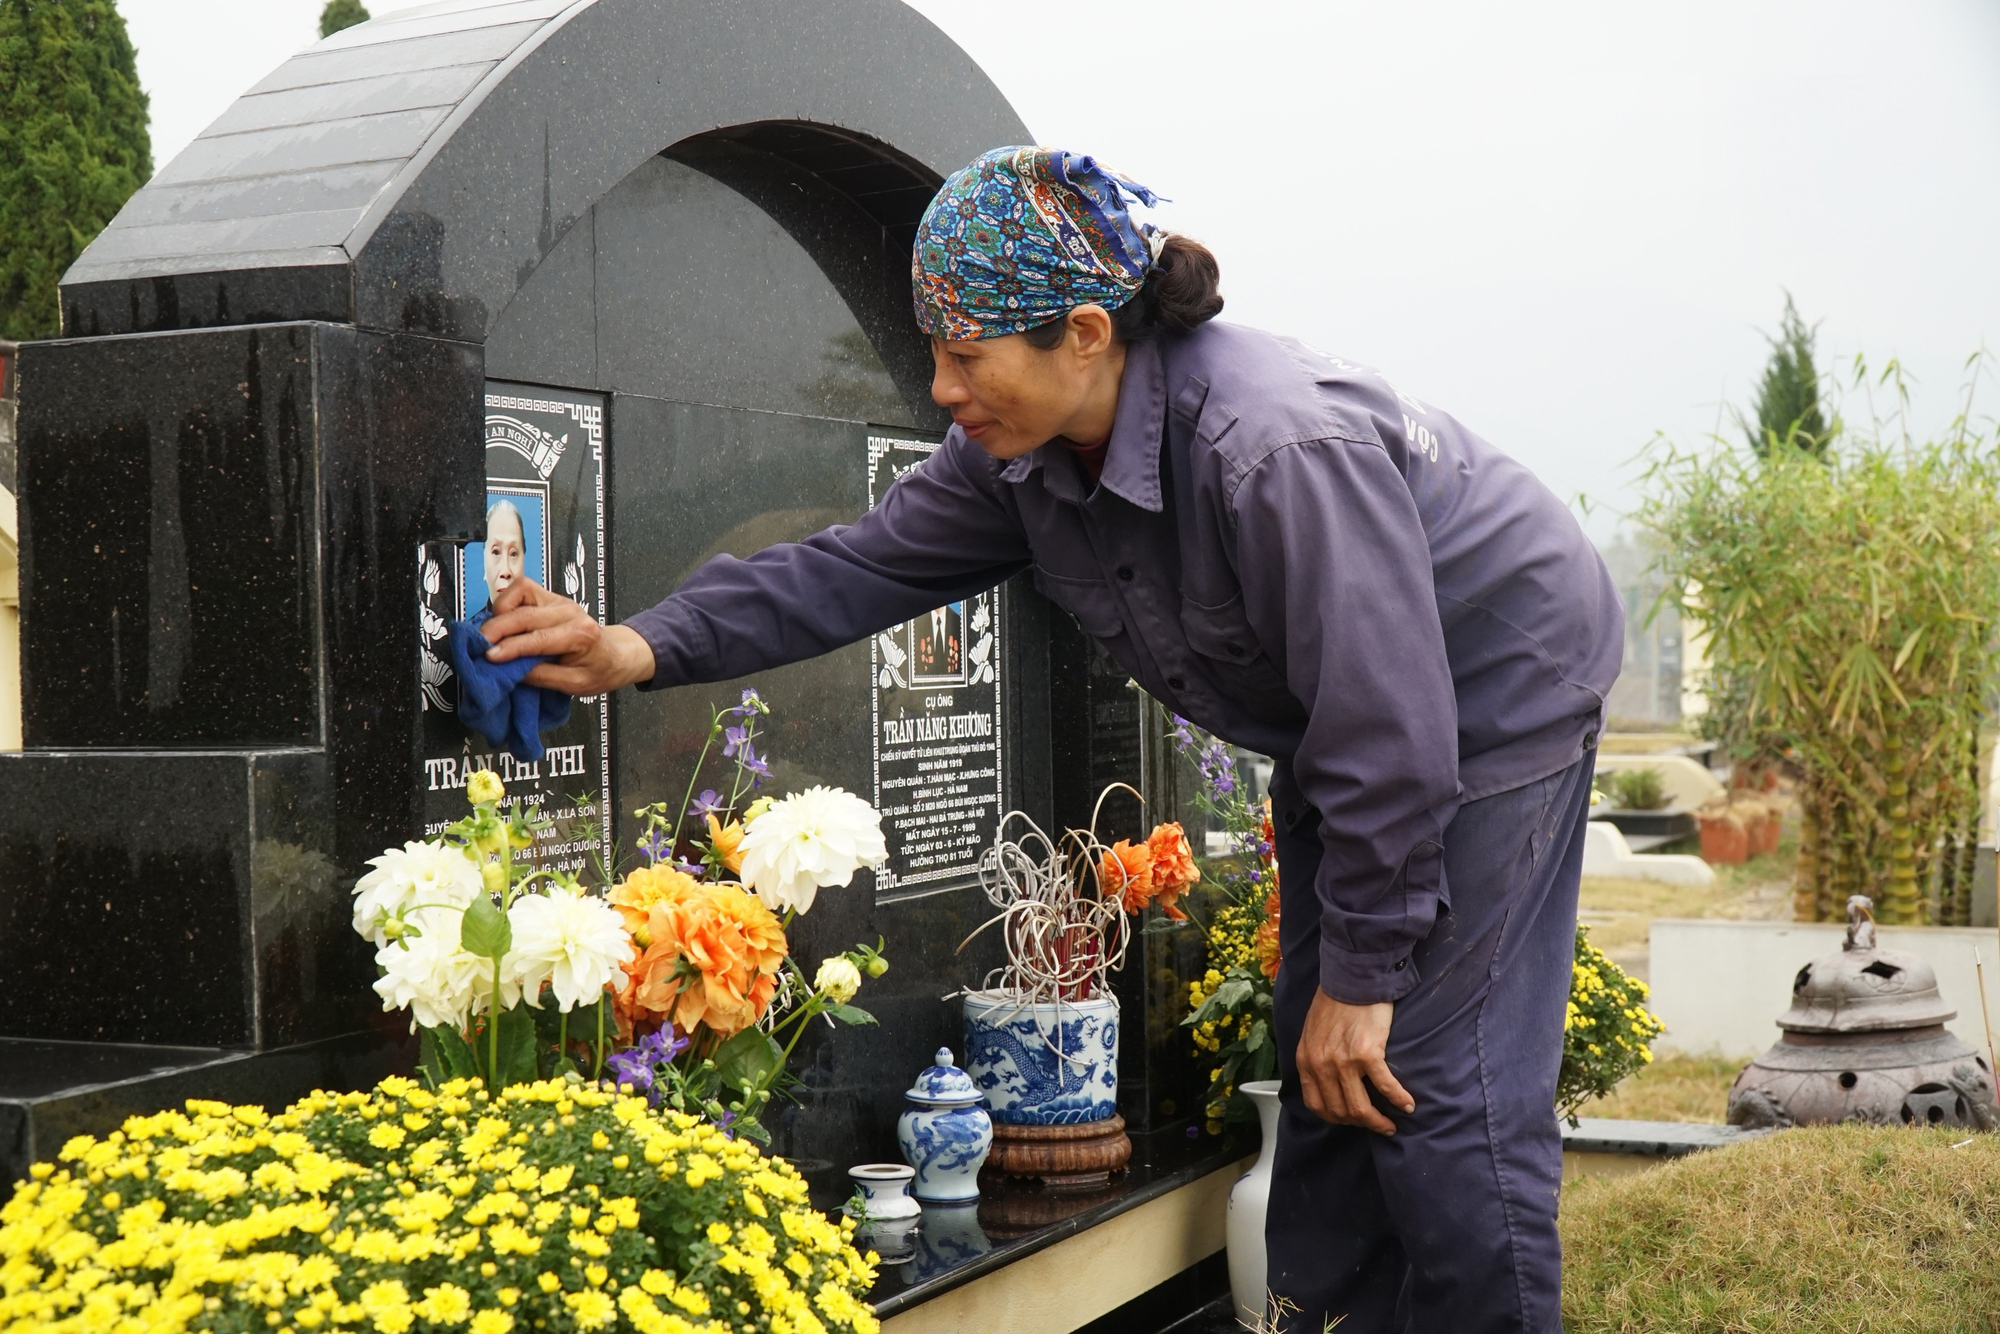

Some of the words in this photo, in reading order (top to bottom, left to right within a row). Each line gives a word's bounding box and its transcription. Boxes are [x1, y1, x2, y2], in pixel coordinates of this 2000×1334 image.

[491, 427, 505, 437] AN
[925, 697, 935, 710] CỤ
[937, 693, 953, 706] ÔNG
[884, 706, 914, 745] TRẦN
[916, 711, 947, 741] NĂNG
[949, 711, 992, 738] KHƯƠNG
[425, 737, 493, 790] TRẦN
[546, 745, 586, 777] THI
[918, 762, 933, 771] SINH
[934, 759, 948, 770] NĂM
[949, 758, 963, 768] 1919
[882, 777, 906, 789] NGUYÊN
[947, 784, 955, 794] HÀ
[956, 784, 968, 793] NAM
[524, 794, 545, 805] 1924
[913, 800, 920, 812] SỐ
[921, 803, 924, 811] 2
[557, 805, 577, 820] X.LA
[578, 805, 596, 817] SƠN
[536, 827, 557, 840] NAM
[906, 827, 920, 841] MẤT
[922, 827, 940, 839] NGÀY
[941, 827, 949, 836] 15
[953, 825, 957, 833] 7
[522, 849, 532, 859] 66
[548, 843, 571, 857] NGỌC
[573, 839, 600, 853] DƯƠNG
[901, 844, 914, 856] TỨC
[916, 841, 934, 853] NGÀY
[935, 841, 942, 850] 03
[948, 840, 952, 848] 6
[966, 834, 981, 845] MÃO
[557, 858, 570, 872] HÀ
[572, 856, 586, 872] NỘI
[910, 854, 934, 868] HƯỞNG
[935, 853, 948, 864] THỌ
[950, 852, 956, 861] 81
[958, 846, 973, 859] TUỔI
